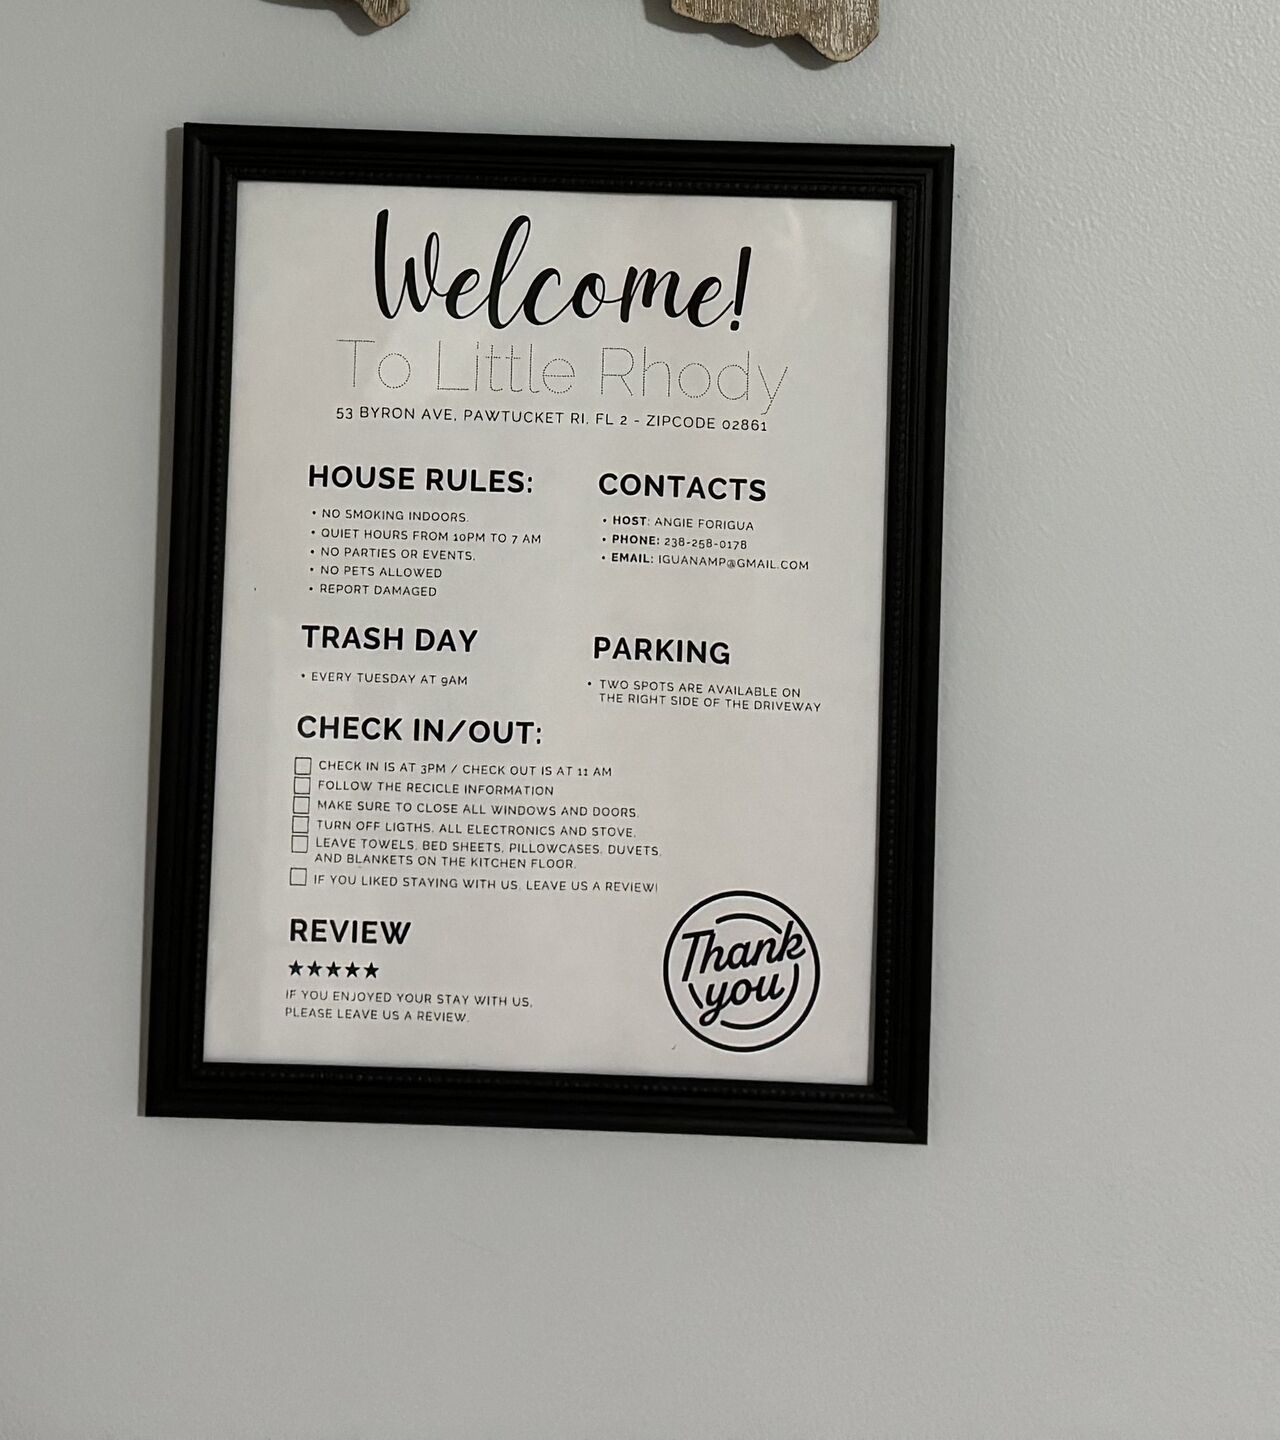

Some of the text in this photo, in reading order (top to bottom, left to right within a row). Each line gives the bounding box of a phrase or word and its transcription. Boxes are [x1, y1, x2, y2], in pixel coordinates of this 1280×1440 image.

[375, 208, 751, 331] Welcome!
[336, 338, 789, 415] To Little Rhody
[336, 407, 353, 419] 53
[359, 405, 415, 420] BYRON
[463, 409, 565, 424] PAWTUCKET
[595, 412, 614, 425] FL
[619, 415, 627, 426] 2
[646, 414, 716, 429] ZIPCODE
[721, 418, 767, 431] 02861
[308, 464, 533, 493] HOUSE RULES:
[598, 472, 766, 502] CONTACTS
[321, 508, 340, 519] NO
[345, 508, 404, 520] SMOKING
[612, 515, 754, 531] HOST: ANGIE FORIGUA
[321, 527, 541, 544] QUIET HOURS FROM 10PM TO 7 AM
[612, 533, 747, 550] PHONE: 238-258-0178
[320, 546, 340, 557] NO
[344, 546, 396, 559] PARTIES
[400, 549, 418, 559] OR
[611, 552, 654, 564] EMAIL:
[320, 565, 442, 578] NO PETS ALLOWED
[319, 583, 437, 597] REPORT DAMAGED
[301, 624, 478, 653] TRASH DAY
[593, 636, 730, 665] PARKING
[311, 671, 467, 687] EVERY TUESDAY AT 9AM
[599, 678, 801, 698] TWO SPOTS ARE AVAILABLE ON
[599, 692, 821, 712] THE RIGHT SIDE OF THE DRIVEWAY
[297, 715, 542, 745] CHECK IN/OUT:
[318, 760, 362, 771] CHECK
[366, 761, 379, 771] IN
[384, 761, 395, 772] IS
[399, 762, 416, 773] AT
[420, 763, 446, 774] 3PM
[462, 764, 505, 775] CHECK
[509, 765, 537, 776] OUT
[541, 765, 552, 776] IS
[556, 766, 573, 776] AT
[577, 767, 588, 777] 11
[592, 766, 612, 777] AM
[318, 779, 554, 796] FOLLOW THE RECICLE INFORMATION
[289, 918, 411, 945] REVIEW
[681, 920, 806, 982] Thank
[698, 968, 783, 1026] you
